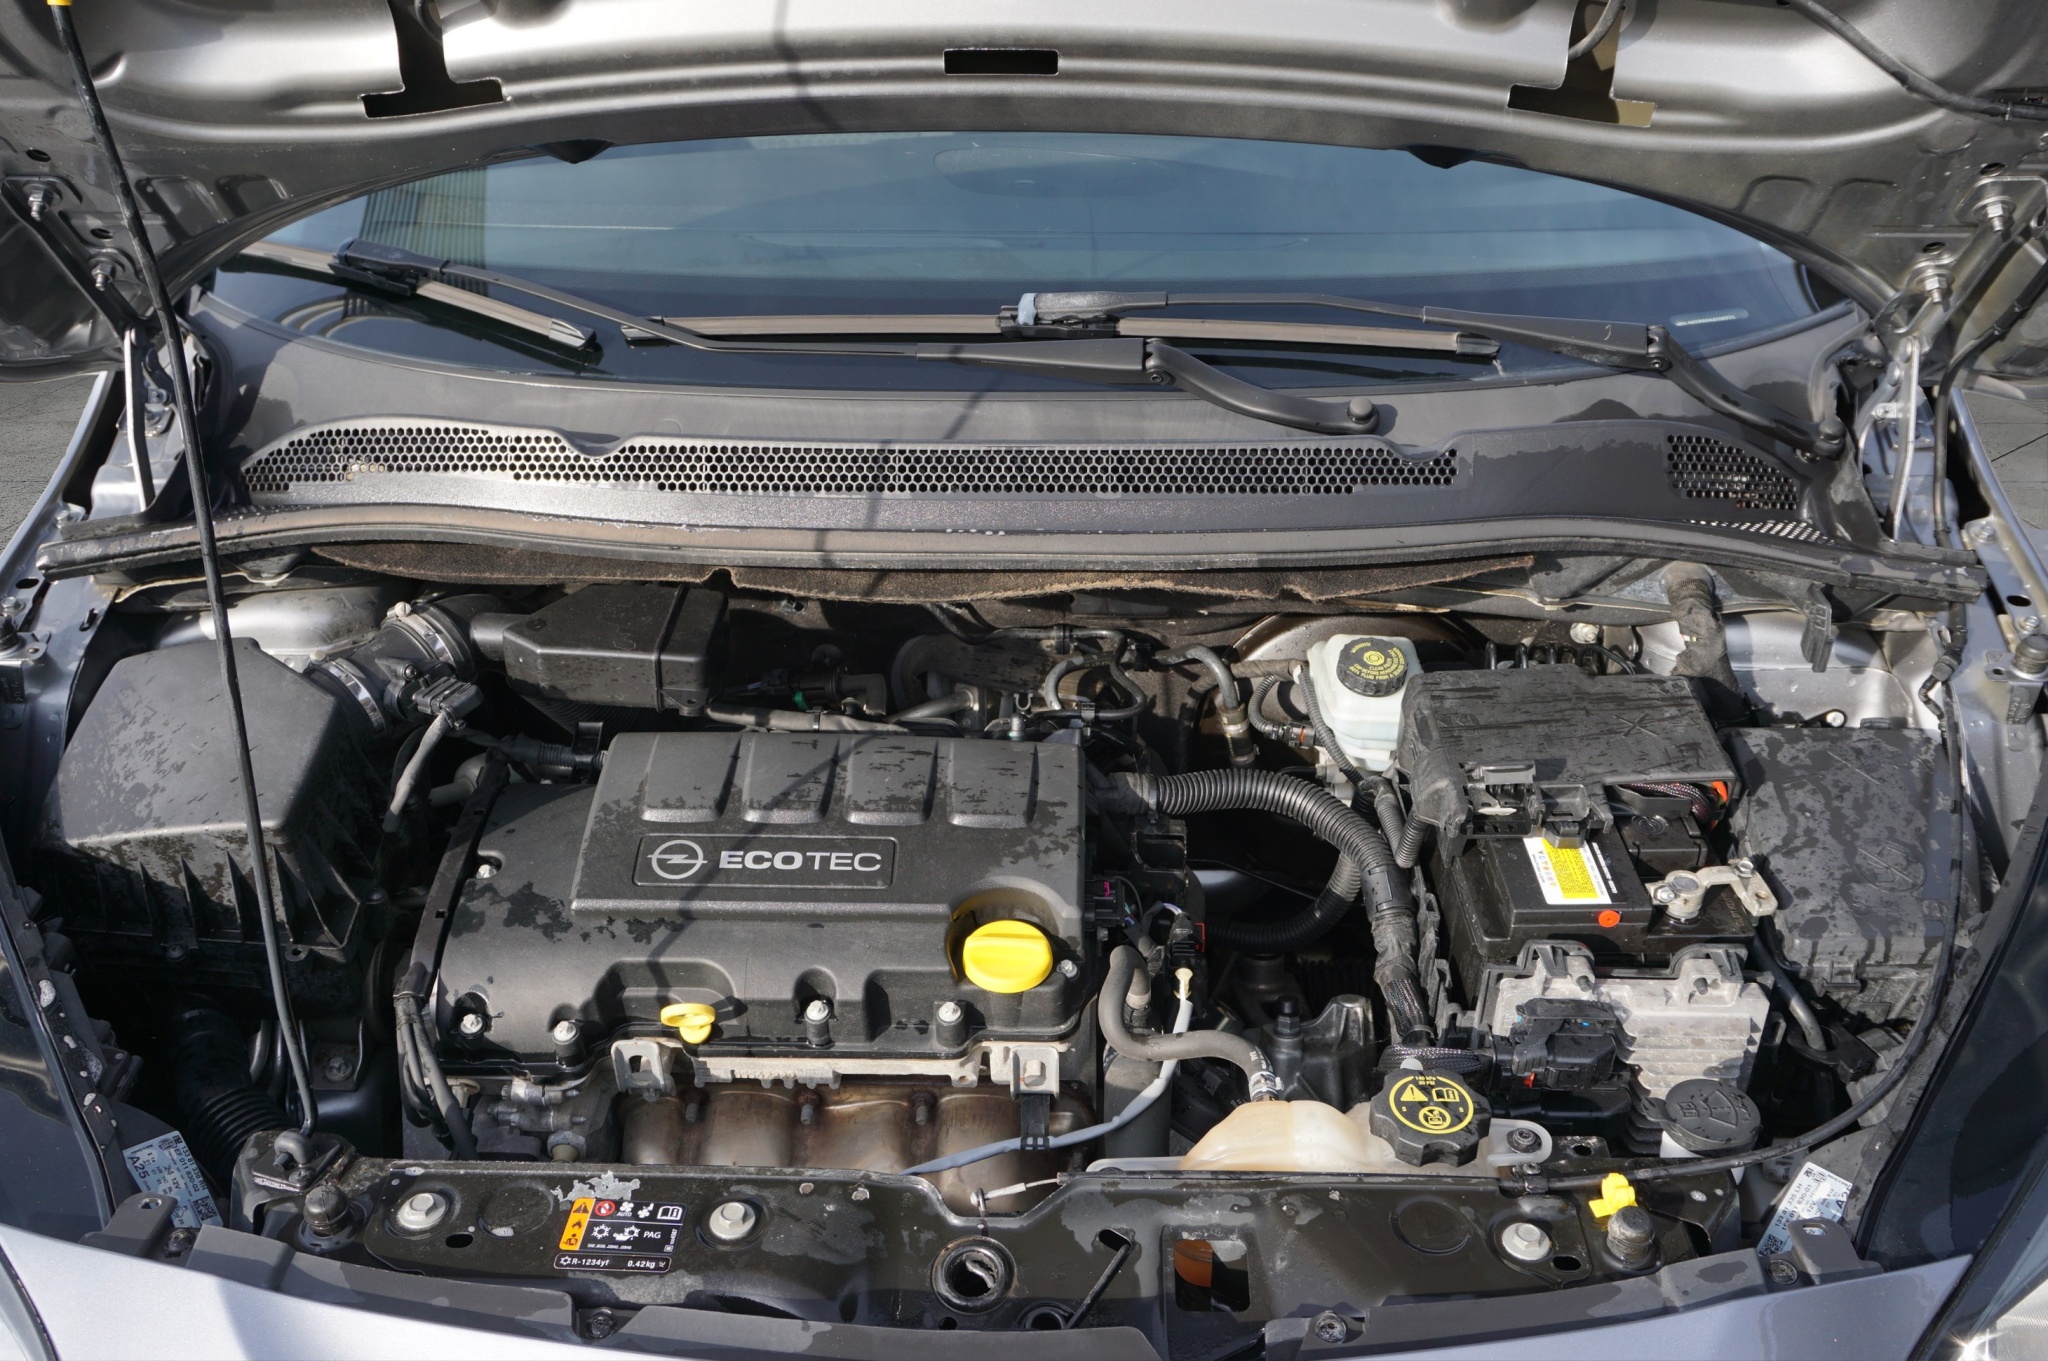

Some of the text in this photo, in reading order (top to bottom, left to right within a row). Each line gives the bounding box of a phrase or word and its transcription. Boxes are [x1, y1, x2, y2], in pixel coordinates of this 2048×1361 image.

[719, 850, 882, 872] ECOTEC
[128, 1155, 150, 1179] A25
[1795, 1183, 1803, 1193] LH
[643, 1230, 662, 1239] PAG
[571, 1258, 656, 1269] R-1234yf 0.42kg
